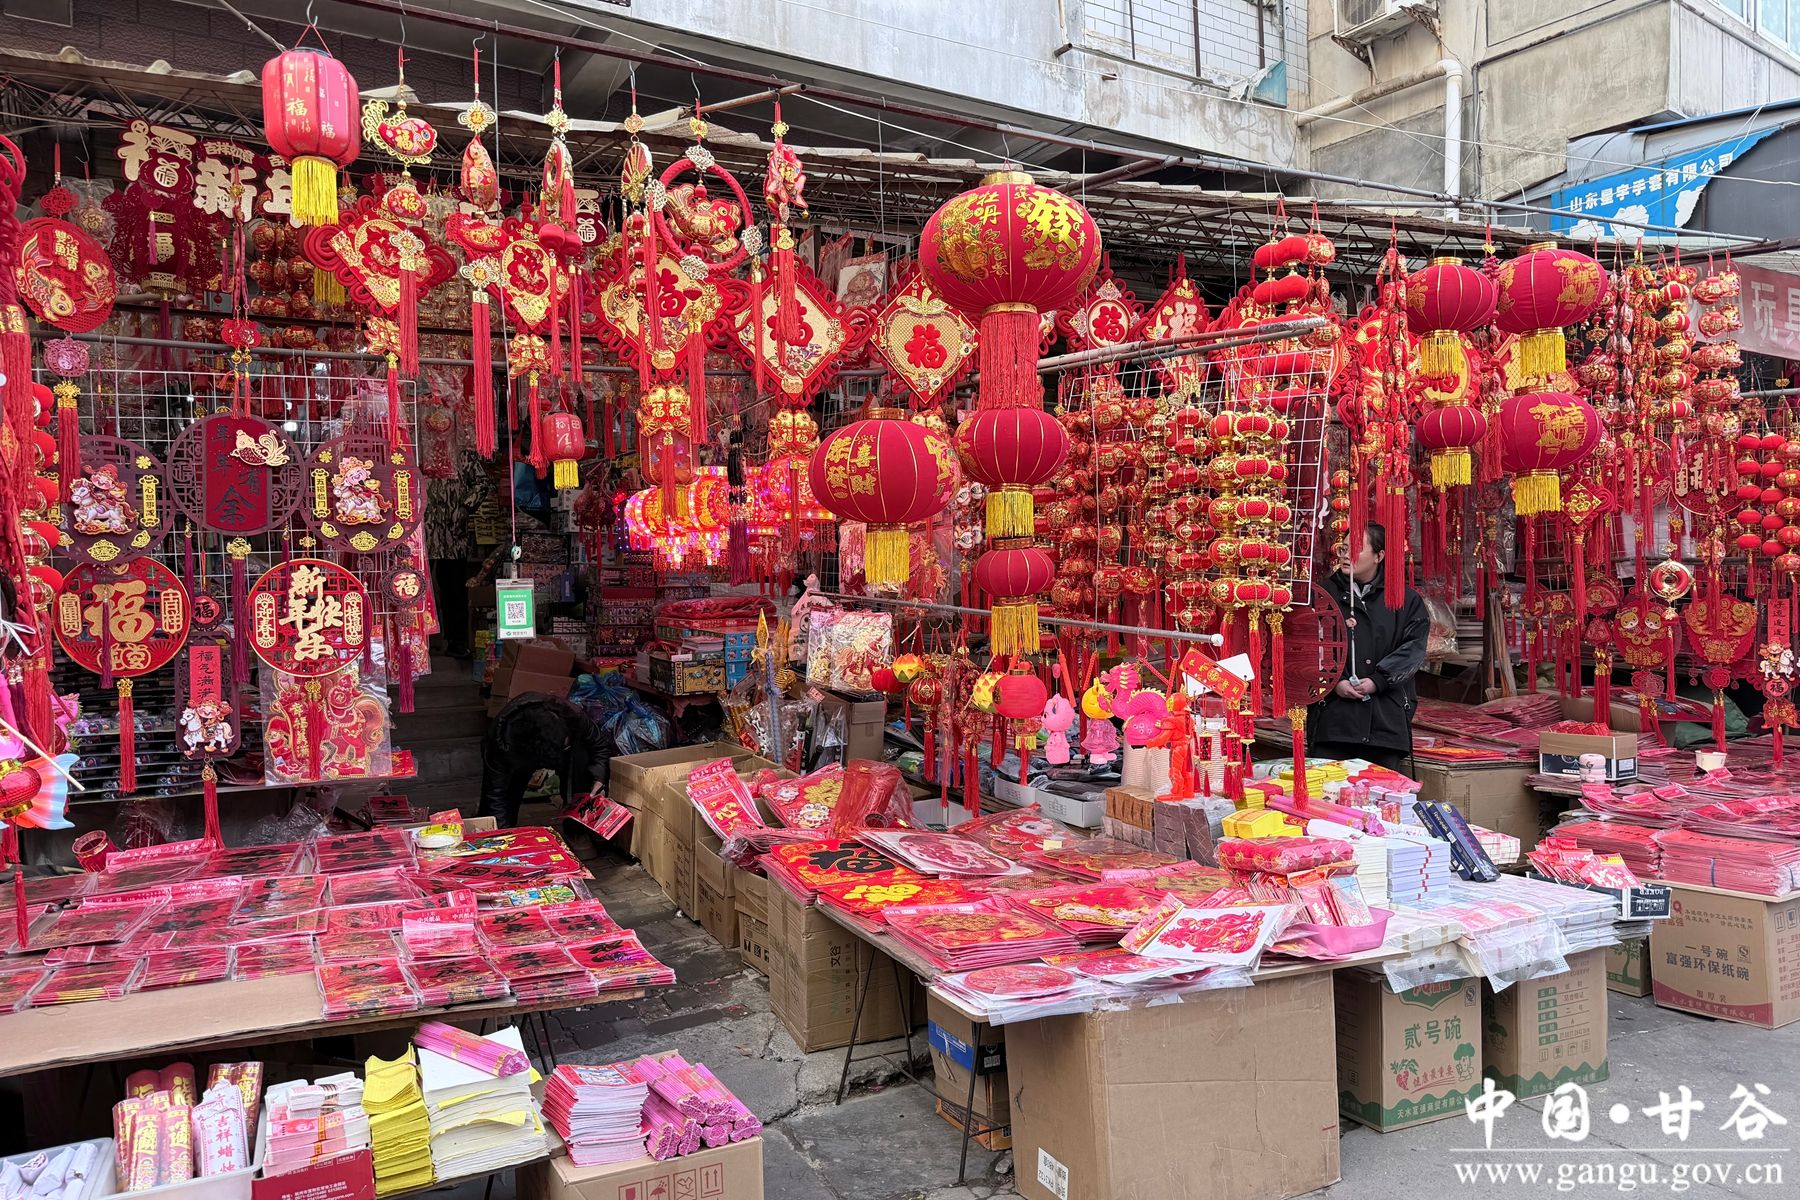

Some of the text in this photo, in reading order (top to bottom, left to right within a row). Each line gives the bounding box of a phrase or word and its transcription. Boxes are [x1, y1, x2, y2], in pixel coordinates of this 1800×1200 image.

[286, 97, 308, 118] 福
[1091, 305, 1126, 341] 福
[903, 323, 948, 369] 福
[315, 476, 329, 509] 五福临门
[393, 573, 420, 598] 福
[83, 579, 156, 643] 福
[195, 601, 216, 620] 福
[278, 564, 345, 661] 新年快乐
[675, 661, 684, 695] SPIDER
[1769, 682, 1785, 694] 福
[1665, 951, 1751, 982] 富强环保纸碗
[1684, 944, 1729, 962] 一号碗
[1403, 1014, 1463, 1051] 贰号碗
[216, 1114, 236, 1173] 吉祥蜡烛
